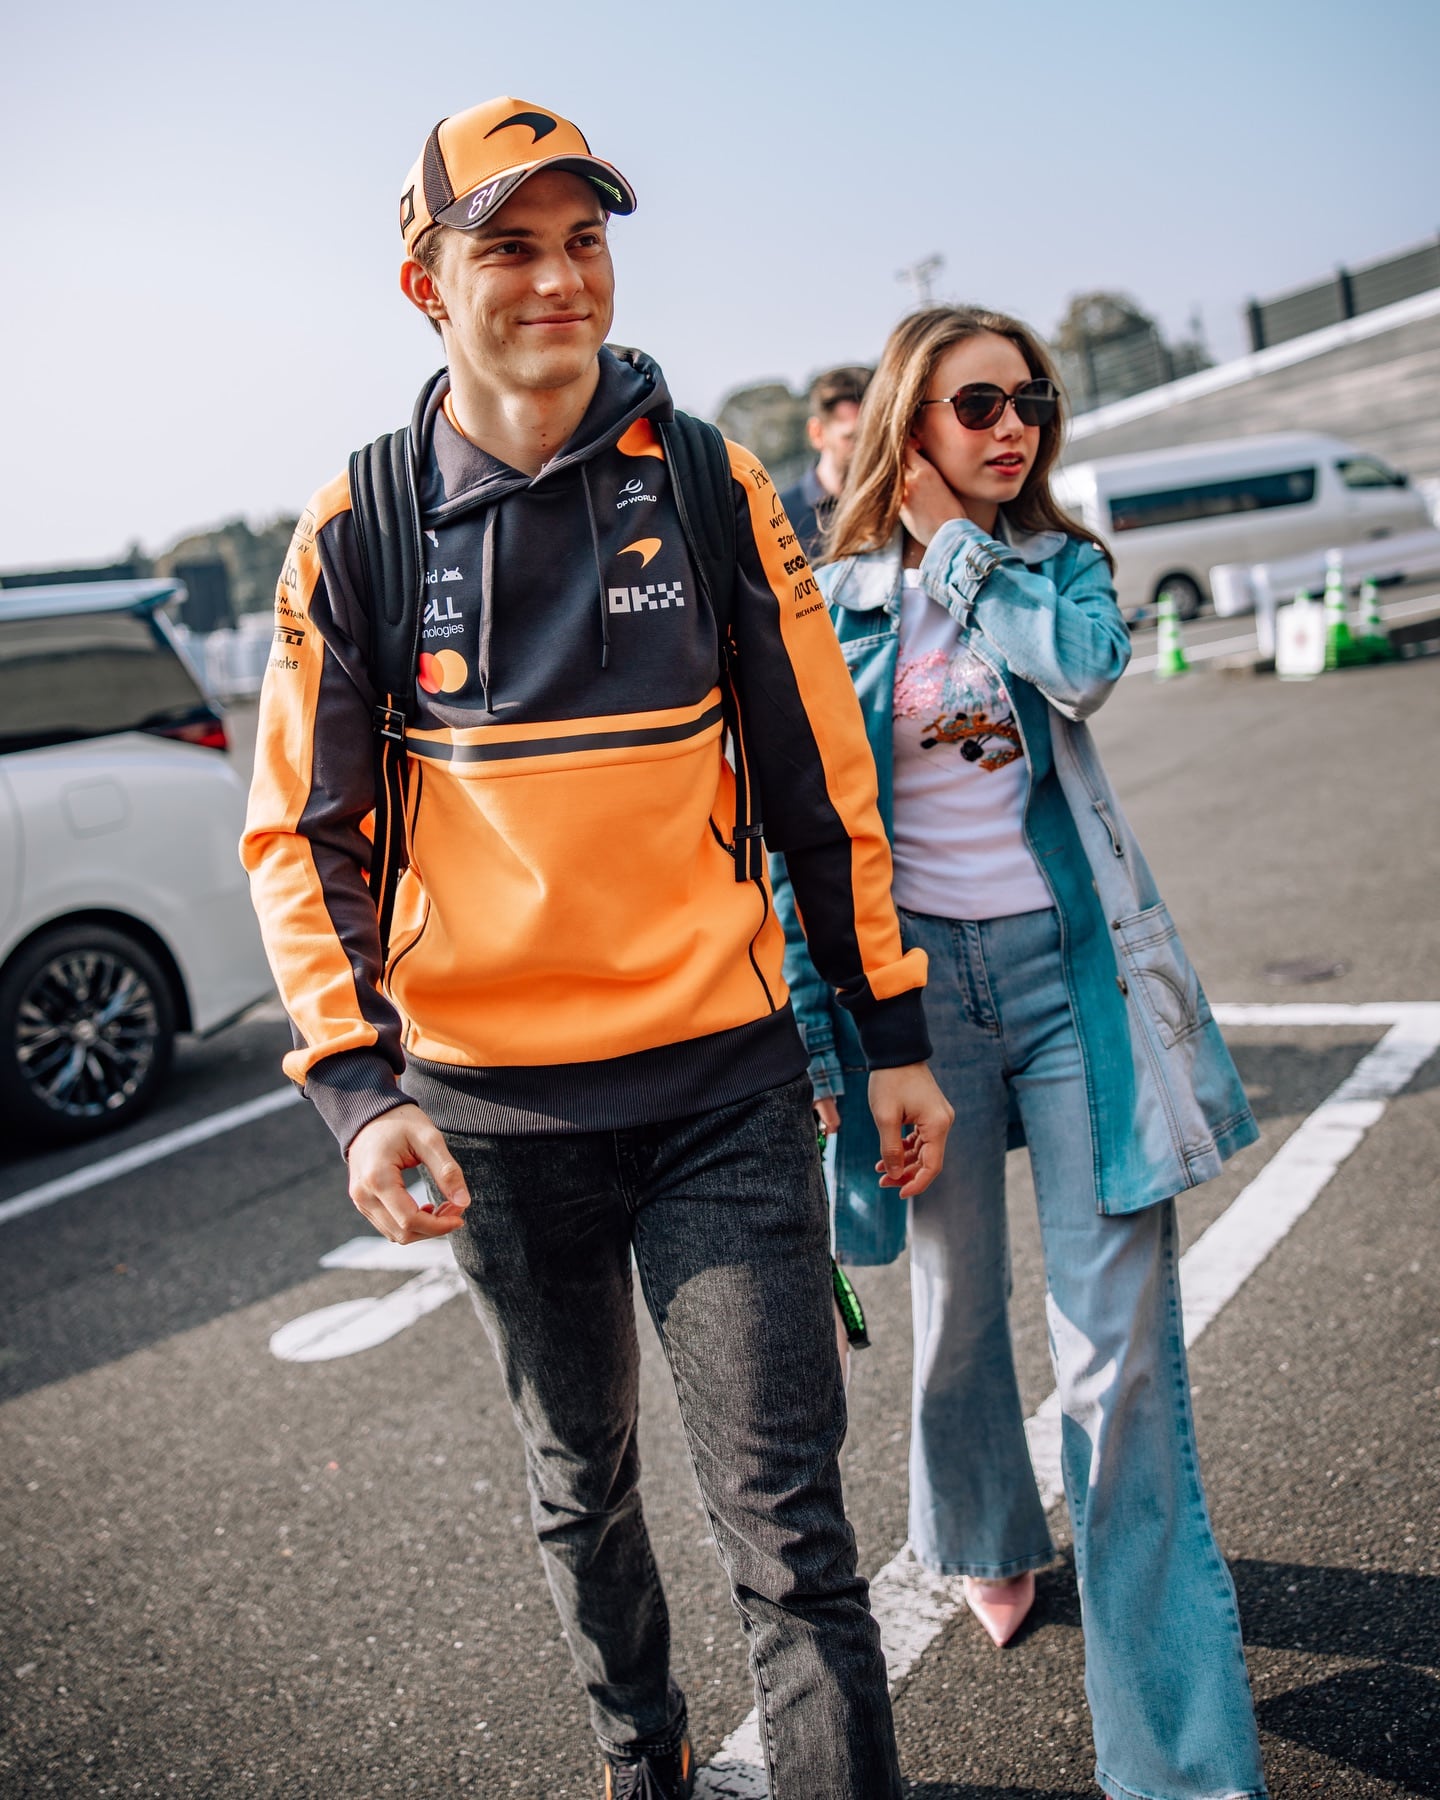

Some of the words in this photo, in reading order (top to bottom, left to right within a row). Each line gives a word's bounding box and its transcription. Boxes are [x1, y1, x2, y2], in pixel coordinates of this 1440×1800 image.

[467, 180, 500, 219] 81
[616, 499, 629, 510] DP
[628, 494, 657, 503] WORLD
[608, 581, 685, 614] OKX
